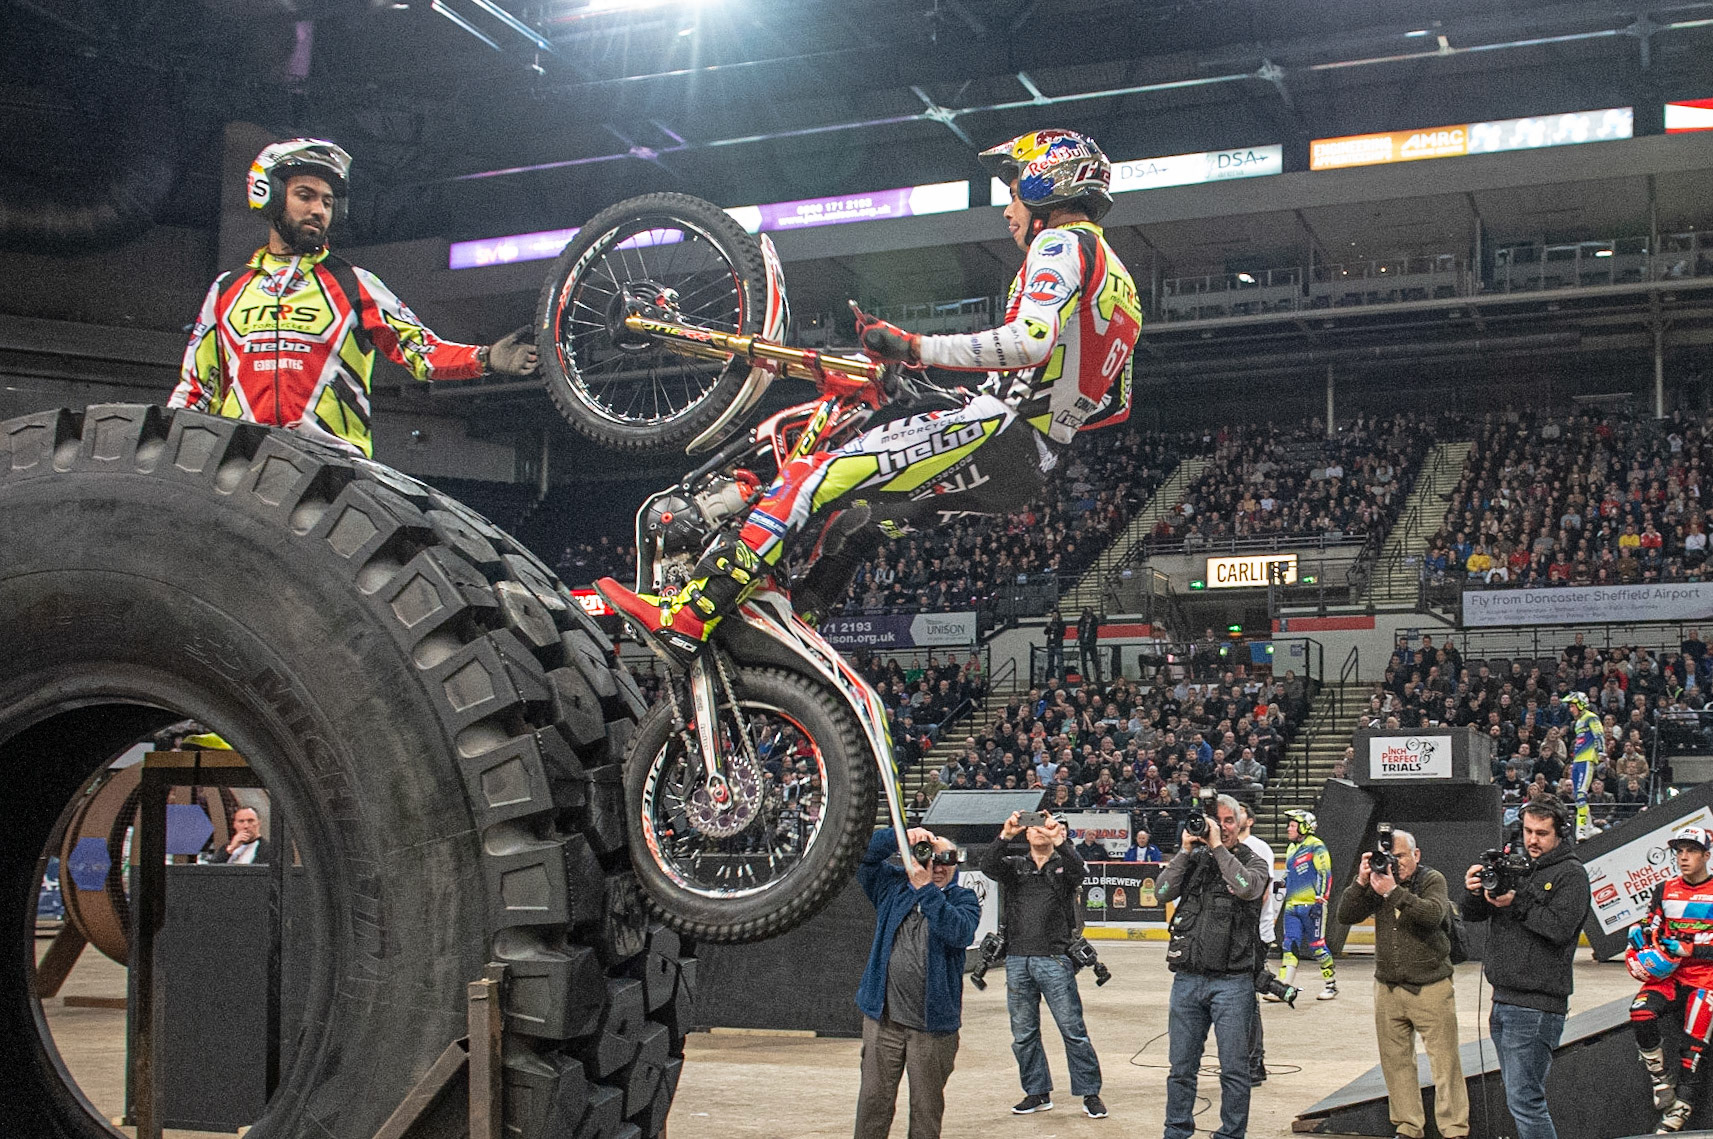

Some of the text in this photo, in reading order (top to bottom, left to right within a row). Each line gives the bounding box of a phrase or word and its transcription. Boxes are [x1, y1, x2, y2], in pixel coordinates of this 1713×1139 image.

[1401, 129, 1464, 150] AMRC
[1027, 152, 1060, 177] Red
[1217, 151, 1258, 169] DSA
[1120, 163, 1160, 180] DSA
[243, 339, 312, 353] hebo
[1101, 338, 1129, 381] 67
[880, 414, 965, 444] MOTORCYCLES
[877, 420, 986, 477] hebo
[1471, 588, 1701, 609] Fly from Doncaster Sheffield Airport
[840, 621, 873, 633] 2193
[926, 624, 966, 635] UNISON
[1381, 763, 1422, 772] TRIALS
[1101, 877, 1142, 888] BREWERY
